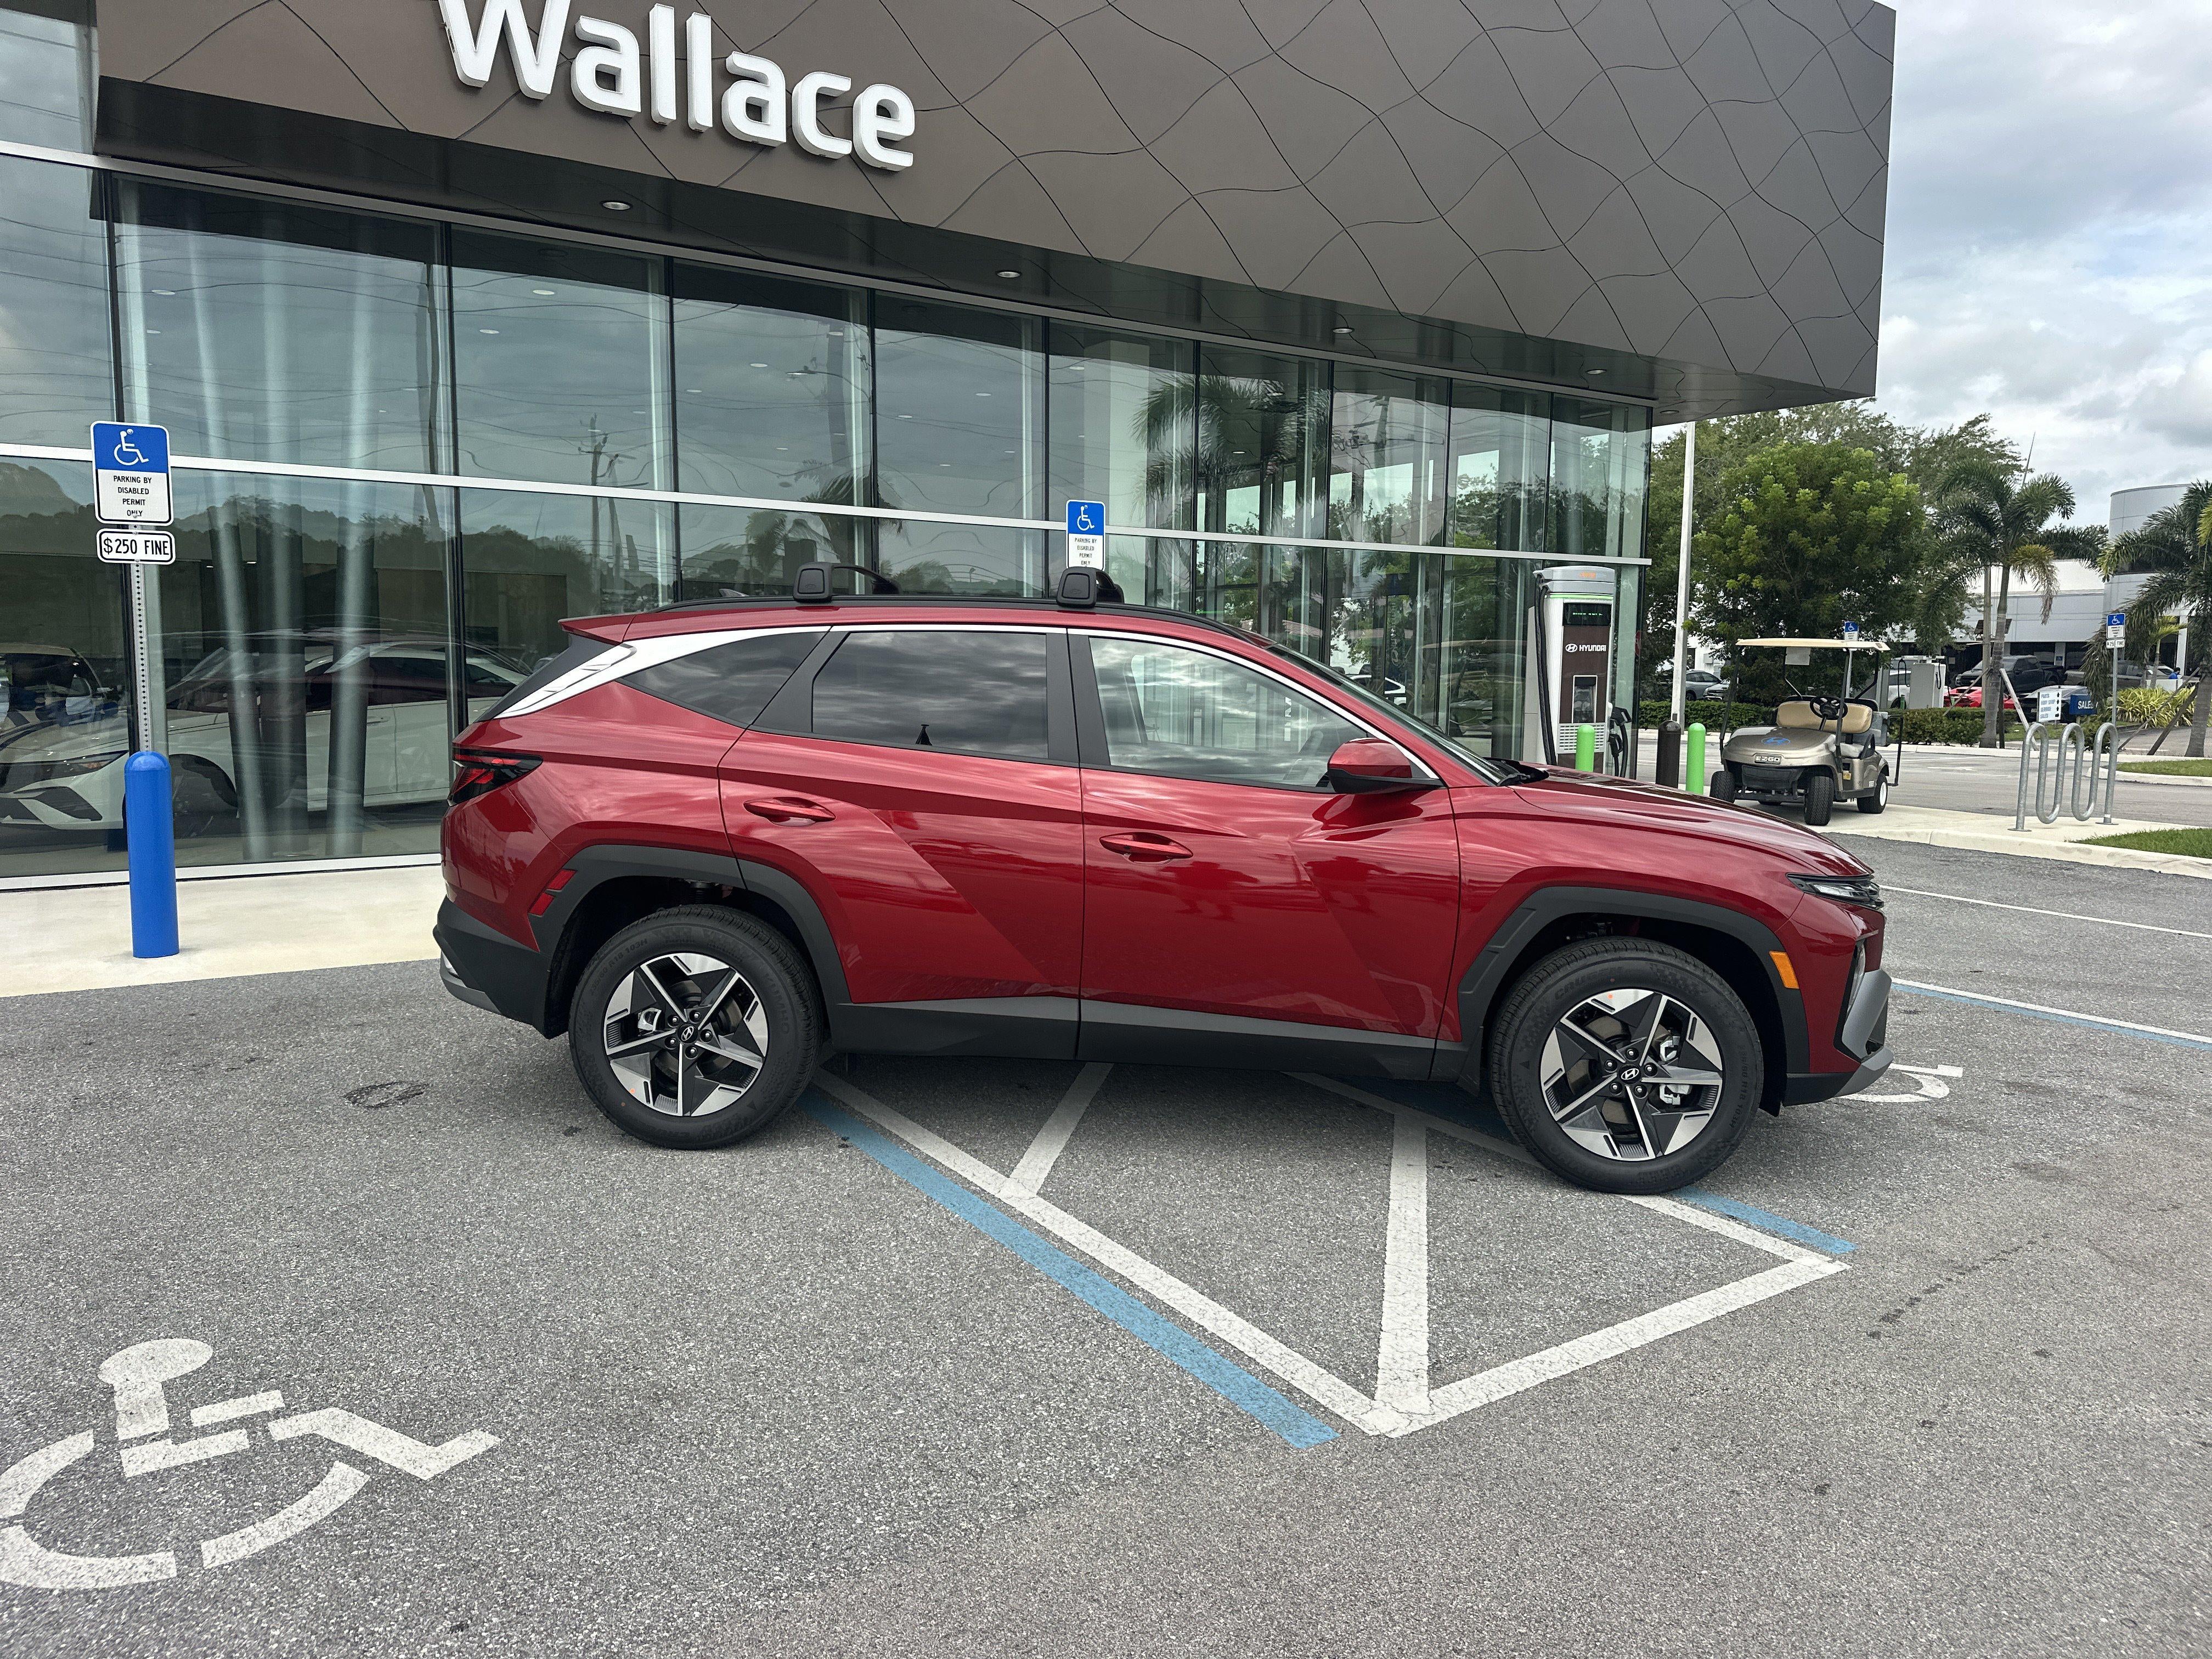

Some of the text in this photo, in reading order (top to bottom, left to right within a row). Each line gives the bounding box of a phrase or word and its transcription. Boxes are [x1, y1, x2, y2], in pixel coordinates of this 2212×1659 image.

[443, 0, 915, 171] Wallace
[113, 475, 141, 483] PARKING
[117, 487, 149, 495] DISABLED
[103, 537, 170, 555] $250 FINE
